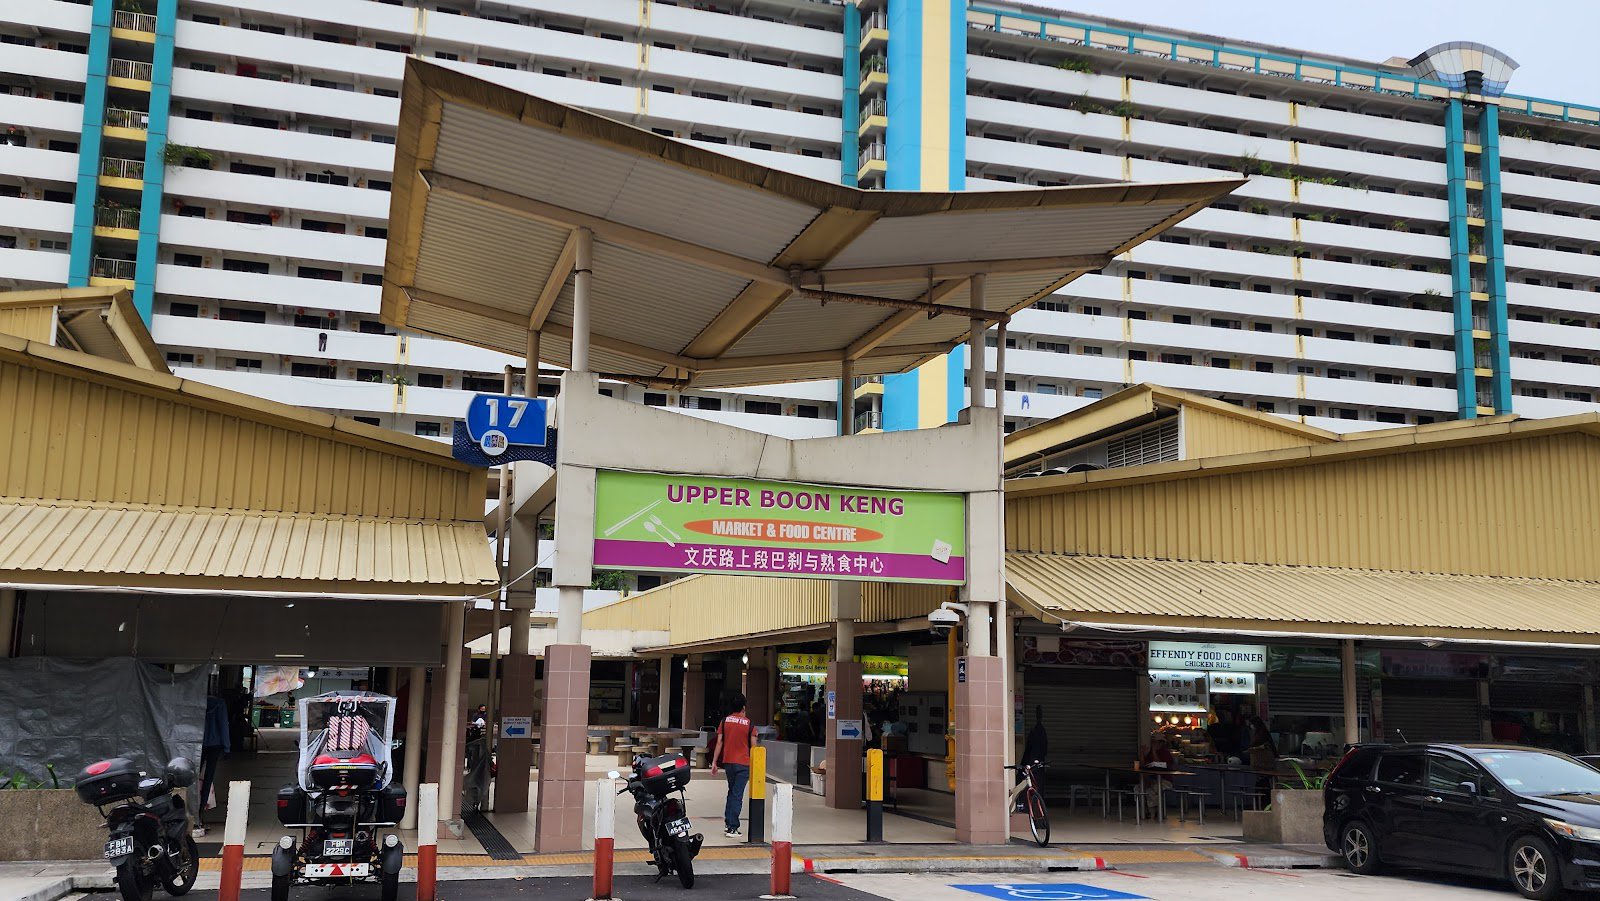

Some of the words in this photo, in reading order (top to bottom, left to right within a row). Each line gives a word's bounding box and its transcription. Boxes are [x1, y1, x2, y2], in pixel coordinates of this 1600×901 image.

[486, 398, 529, 428] 17
[666, 484, 752, 507] UPPER
[760, 490, 832, 512] BOON
[840, 495, 905, 516] KENG
[712, 520, 763, 537] MARKET
[766, 522, 777, 538] &
[779, 524, 810, 540] FOOD
[813, 526, 857, 542] CENTRE
[684, 547, 885, 573] 文庆路上段巴刹与熟食中心
[1150, 649, 1196, 660] EFFENDY
[1197, 651, 1222, 661] FOOD
[1224, 653, 1264, 663] CORNER
[1184, 660, 1214, 669] CHICKEN
[108, 838, 127, 850] FBM
[331, 839, 346, 848] FBM
[104, 845, 132, 858] 5283A
